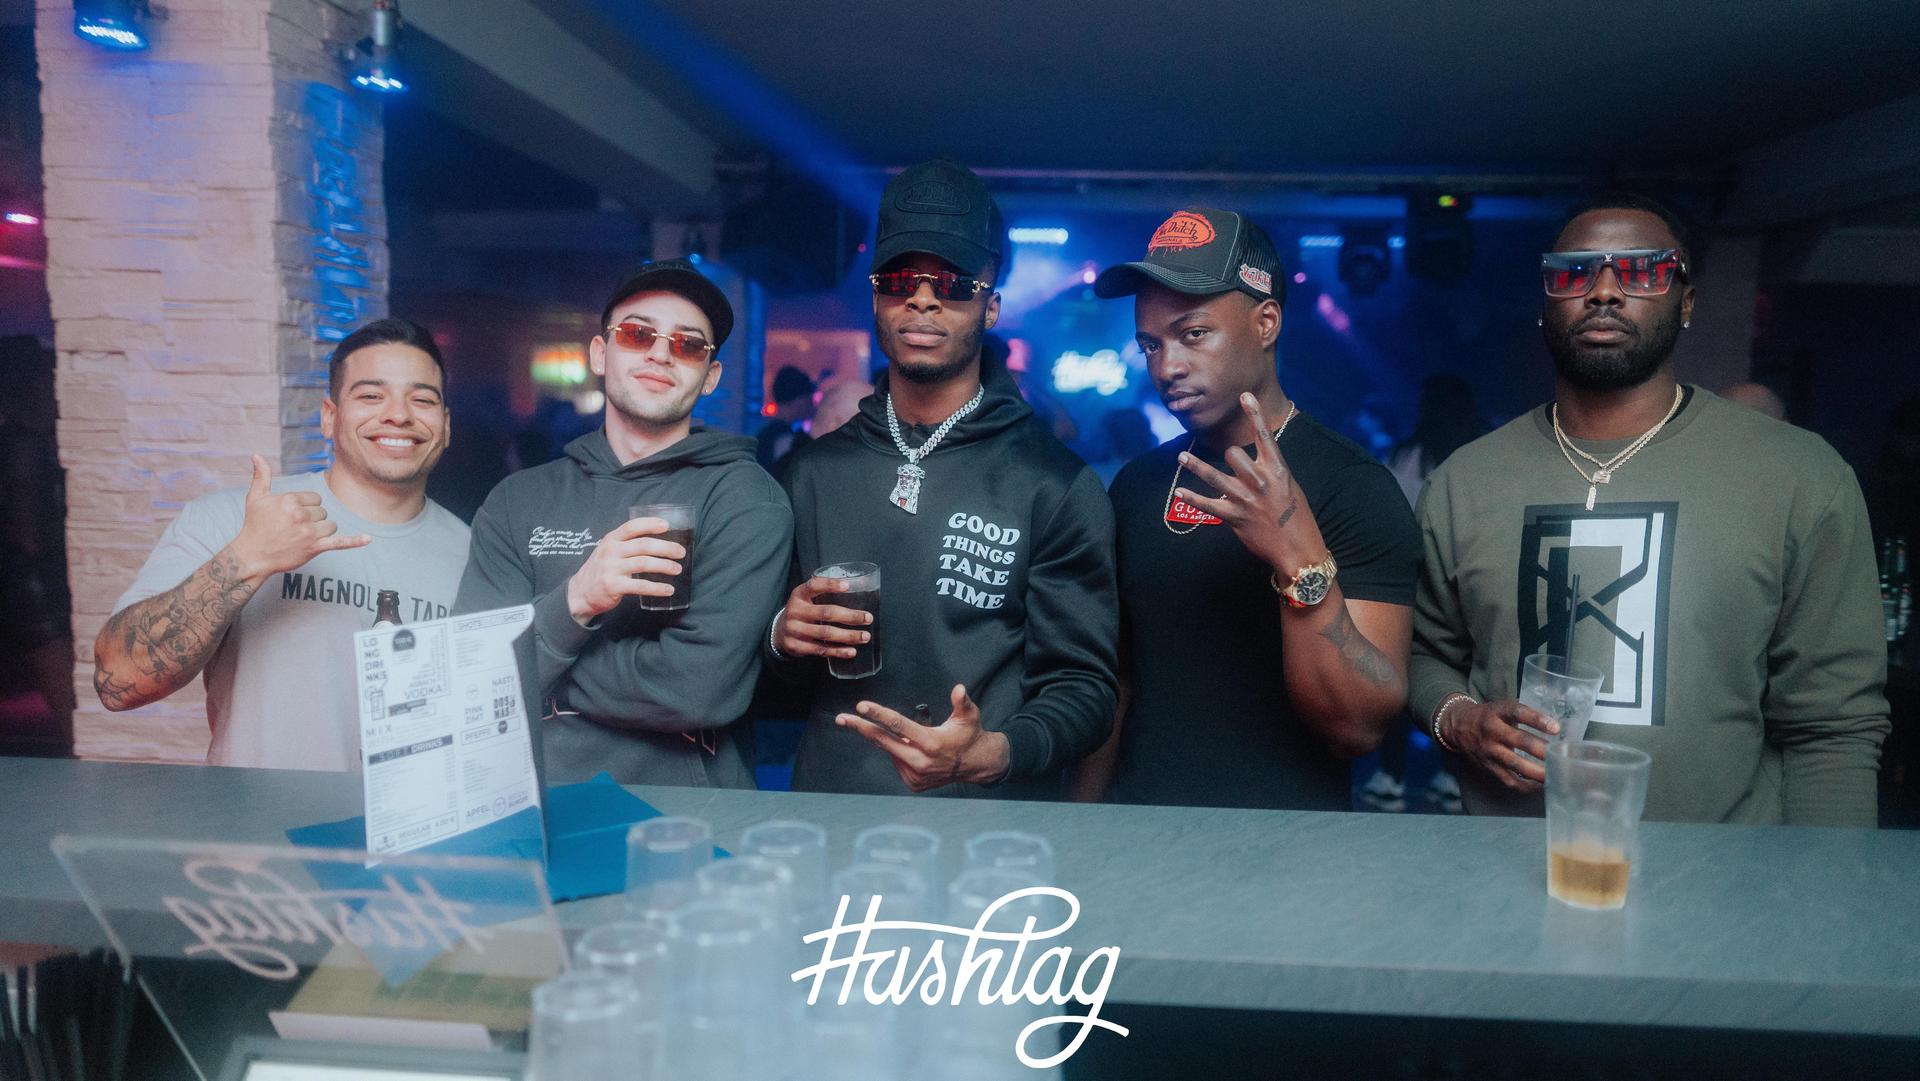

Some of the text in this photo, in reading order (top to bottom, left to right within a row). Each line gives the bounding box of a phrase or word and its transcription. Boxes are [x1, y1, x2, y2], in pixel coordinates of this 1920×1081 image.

[1167, 220, 1199, 241] Dutch
[948, 512, 1020, 546] GOOD
[942, 535, 1016, 565] THINGS
[939, 553, 1010, 586] TAKE
[281, 572, 452, 621] MAGNOL TA
[936, 577, 1006, 610] TIME
[363, 637, 378, 648] LO
[364, 660, 384, 671] DRI
[365, 671, 388, 681] NKS
[404, 684, 443, 700] VODKA
[411, 738, 443, 753] DRINKS
